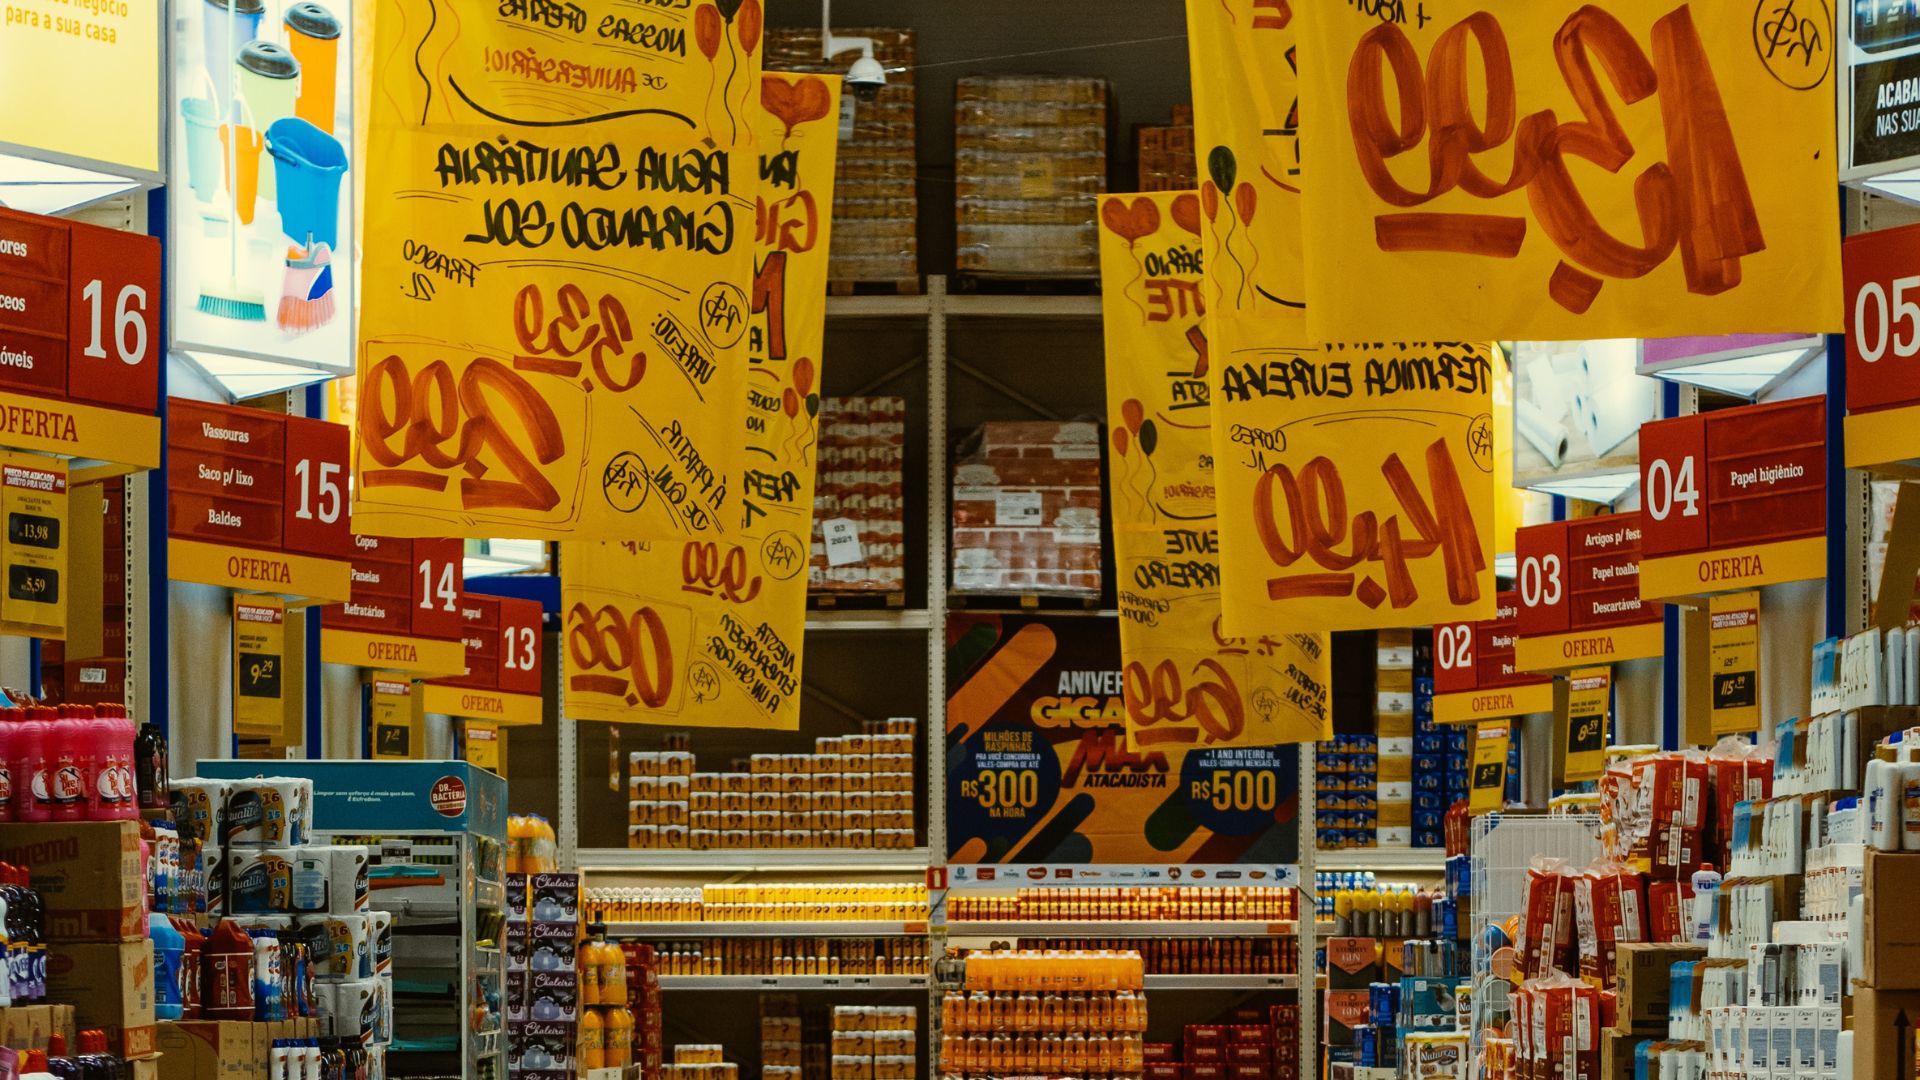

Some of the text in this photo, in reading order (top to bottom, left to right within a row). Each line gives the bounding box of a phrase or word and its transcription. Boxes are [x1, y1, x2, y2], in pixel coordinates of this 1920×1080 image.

[6, 5, 116, 43] para a sua casa
[1877, 112, 1899, 137] NAS
[83, 279, 147, 365] 16
[1855, 275, 1920, 363] 05
[202, 422, 249, 443] Vassouras
[199, 464, 253, 486] Saco p/ lixo
[1731, 463, 1804, 487] Papel higiênico
[295, 459, 341, 524] 15
[1647, 456, 1699, 521] 04
[208, 509, 241, 527] Baldes
[355, 535, 378, 549] Copos
[1585, 529, 1624, 547] Artigos p/
[228, 556, 291, 583] OFERTA
[351, 569, 380, 583] Panelas
[1593, 566, 1614, 581] Papel
[1699, 555, 1763, 582] OFERTA
[419, 559, 457, 611] 14
[1521, 554, 1561, 607] 03
[344, 602, 385, 618] Refratários
[1593, 599, 1641, 615] Descartáveis
[367, 641, 418, 662] OFERTA
[504, 626, 536, 671] 13
[1438, 625, 1472, 670] 02
[1563, 636, 1615, 658] OFERTA
[462, 695, 503, 713] OFERTA
[1472, 694, 1514, 712] OFERTA
[1218, 749, 1233, 759] ANO
[1235, 749, 1265, 759] INTEIRO
[1084, 774, 1166, 788] ATACADISTA
[1003, 807, 1026, 817] HORA
[536, 875, 576, 888] Chaleira
[534, 924, 574, 937] Chaleira
[535, 973, 575, 987] Chaleira
[524, 1022, 565, 1035] Chaleira
